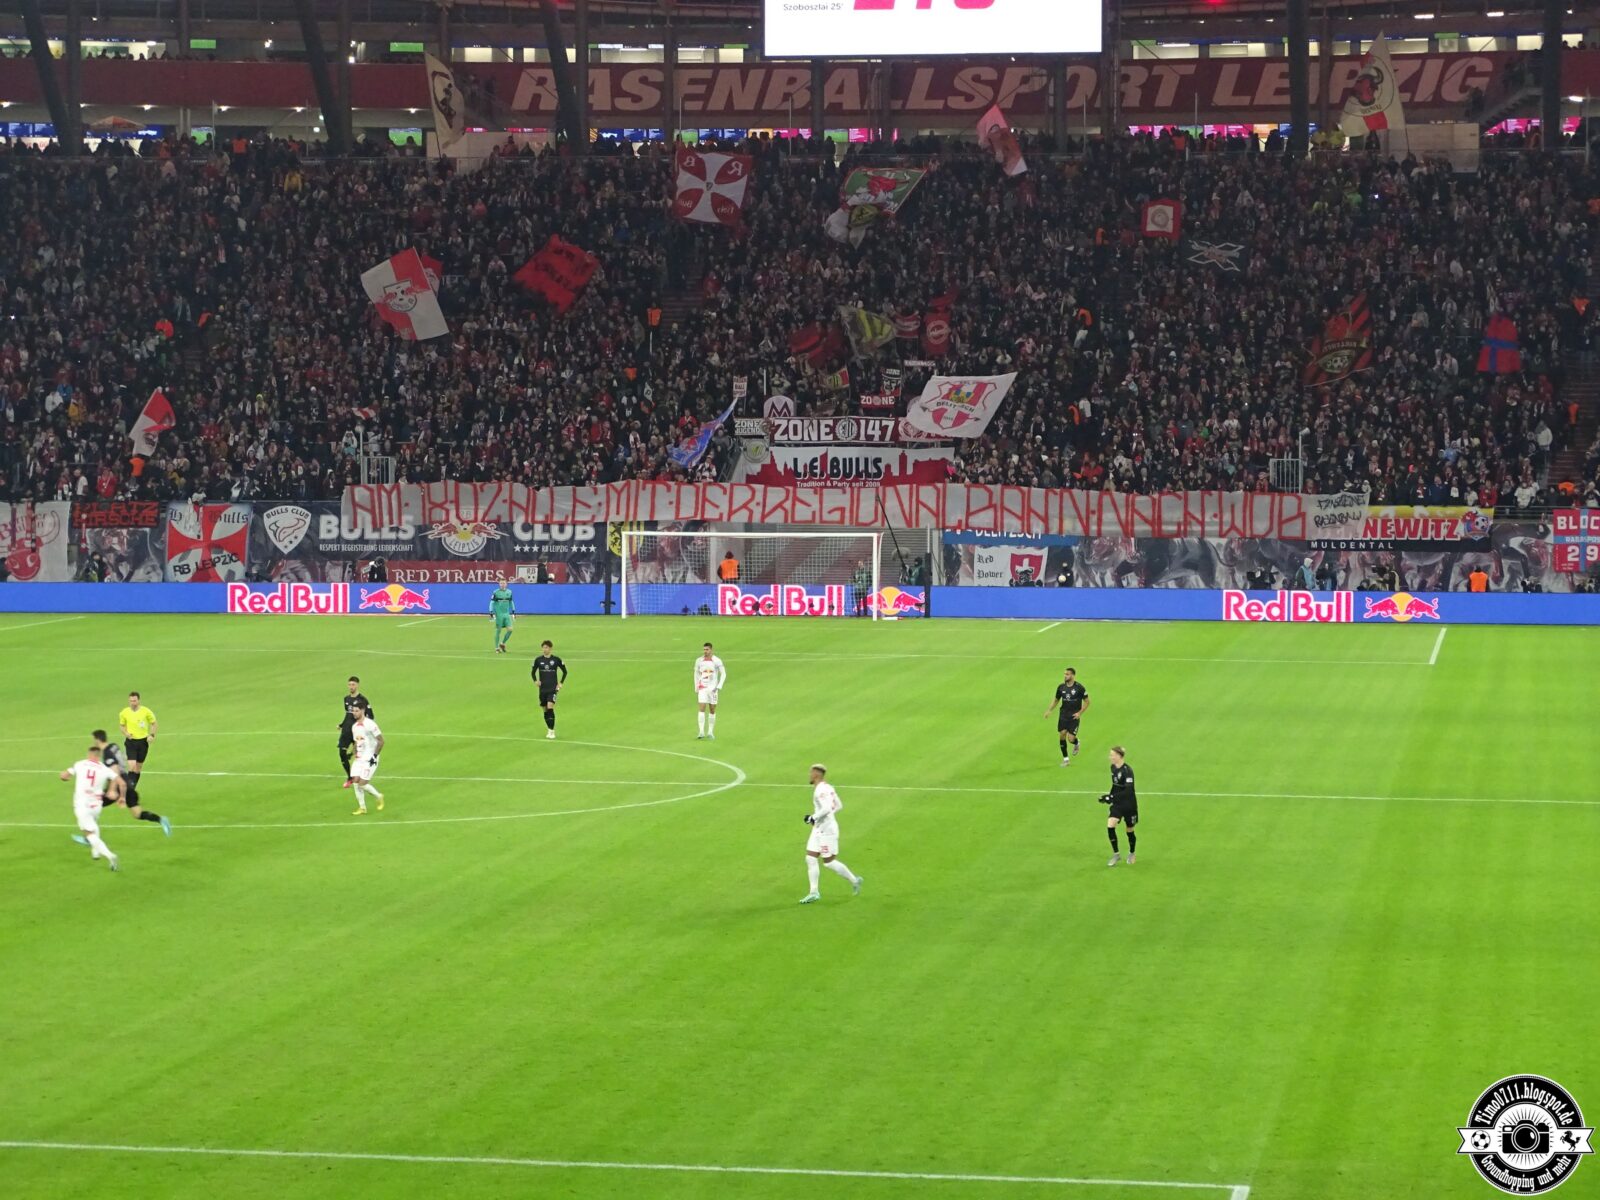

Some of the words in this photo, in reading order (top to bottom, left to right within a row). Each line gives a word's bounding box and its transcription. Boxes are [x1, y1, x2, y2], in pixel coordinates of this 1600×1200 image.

[783, 3, 829, 11] Szoboszlai
[832, 2, 843, 10] 25'
[511, 64, 1197, 111] RASENBALLSPORT
[1212, 56, 1494, 107] LEIPZIG
[734, 420, 760, 429] ZONE
[774, 419, 833, 441] ZONE
[859, 420, 895, 442] 147
[829, 456, 883, 481] BULLS
[833, 481, 850, 489] Party
[266, 507, 289, 520] BULLS
[291, 508, 310, 519] CLUB
[351, 484, 400, 528] AM
[509, 482, 599, 525] ALLES
[605, 479, 672, 521] MIT
[674, 481, 756, 522] DER
[760, 483, 1090, 537] REGIONALBAHN
[1098, 488, 1213, 538] NACH
[1217, 491, 1307, 540] WOB
[319, 514, 415, 540] BULLS
[513, 514, 596, 541] CLUB
[319, 543, 341, 552] RESPEKT
[342, 543, 378, 552] BEGEISTERUNG
[379, 543, 413, 552] LEIDENSCHAFT
[550, 544, 568, 552] LEIPZIG
[1310, 540, 1394, 549] MULDENTAL
[173, 563, 191, 576] RB
[195, 552, 239, 572] LEIPZIG
[977, 554, 994, 564] Red
[392, 569, 430, 583] RED
[433, 568, 506, 583] PIRATES
[976, 569, 1004, 579] Power
[227, 583, 288, 614] Red
[290, 583, 349, 614] Bull
[718, 584, 781, 615] Red
[784, 584, 845, 615] Bull
[1222, 589, 1289, 621] Red
[1290, 590, 1354, 622] Bull
[86, 769, 96, 787] 4
